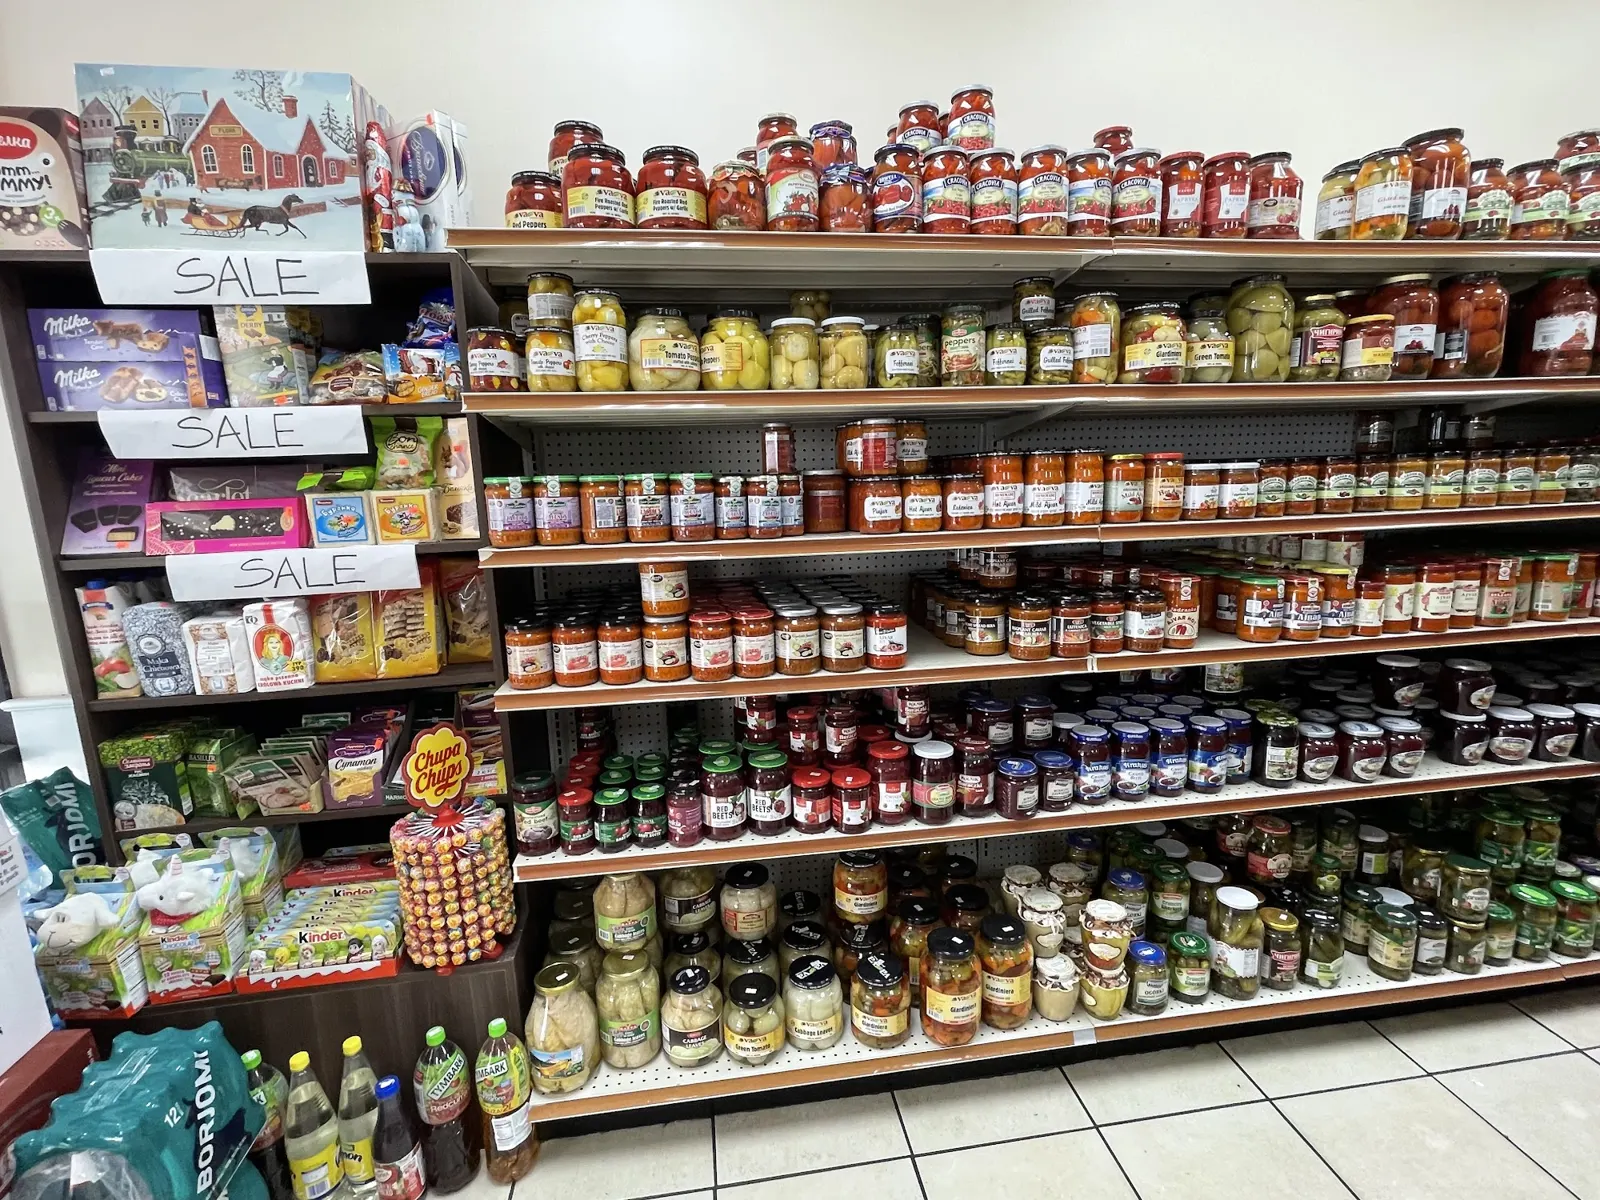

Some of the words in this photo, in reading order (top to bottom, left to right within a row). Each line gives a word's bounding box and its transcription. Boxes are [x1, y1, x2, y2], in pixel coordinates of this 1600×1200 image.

[962, 113, 988, 122] CRACOVIA
[1036, 174, 1062, 184] CRACOVIA
[1120, 177, 1147, 189] CRACOVIA
[975, 180, 1001, 190] CRACOVIA
[173, 256, 320, 298] SALE
[44, 314, 91, 336] Milka
[944, 337, 977, 348] peppers
[665, 351, 686, 360] Tomato
[1194, 353, 1212, 361] Green
[1214, 352, 1231, 361] Tomato
[54, 366, 101, 388] Milka
[172, 413, 303, 450] SALE
[234, 554, 366, 588] SALE
[1166, 616, 1186, 626] AJVAR
[414, 742, 461, 769] Chupa
[335, 758, 377, 770] Cynamon
[415, 759, 462, 797] Chups
[756, 798, 767, 807] RED
[717, 805, 728, 813] RED
[752, 804, 771, 813] BEETS
[713, 811, 733, 820] BEETS
[54, 781, 98, 868] ORJOMI
[682, 1034, 708, 1045] CABBAGE
[735, 1043, 750, 1052] Green
[750, 1044, 771, 1052] Tomato
[430, 1057, 464, 1098] TYMBARK
